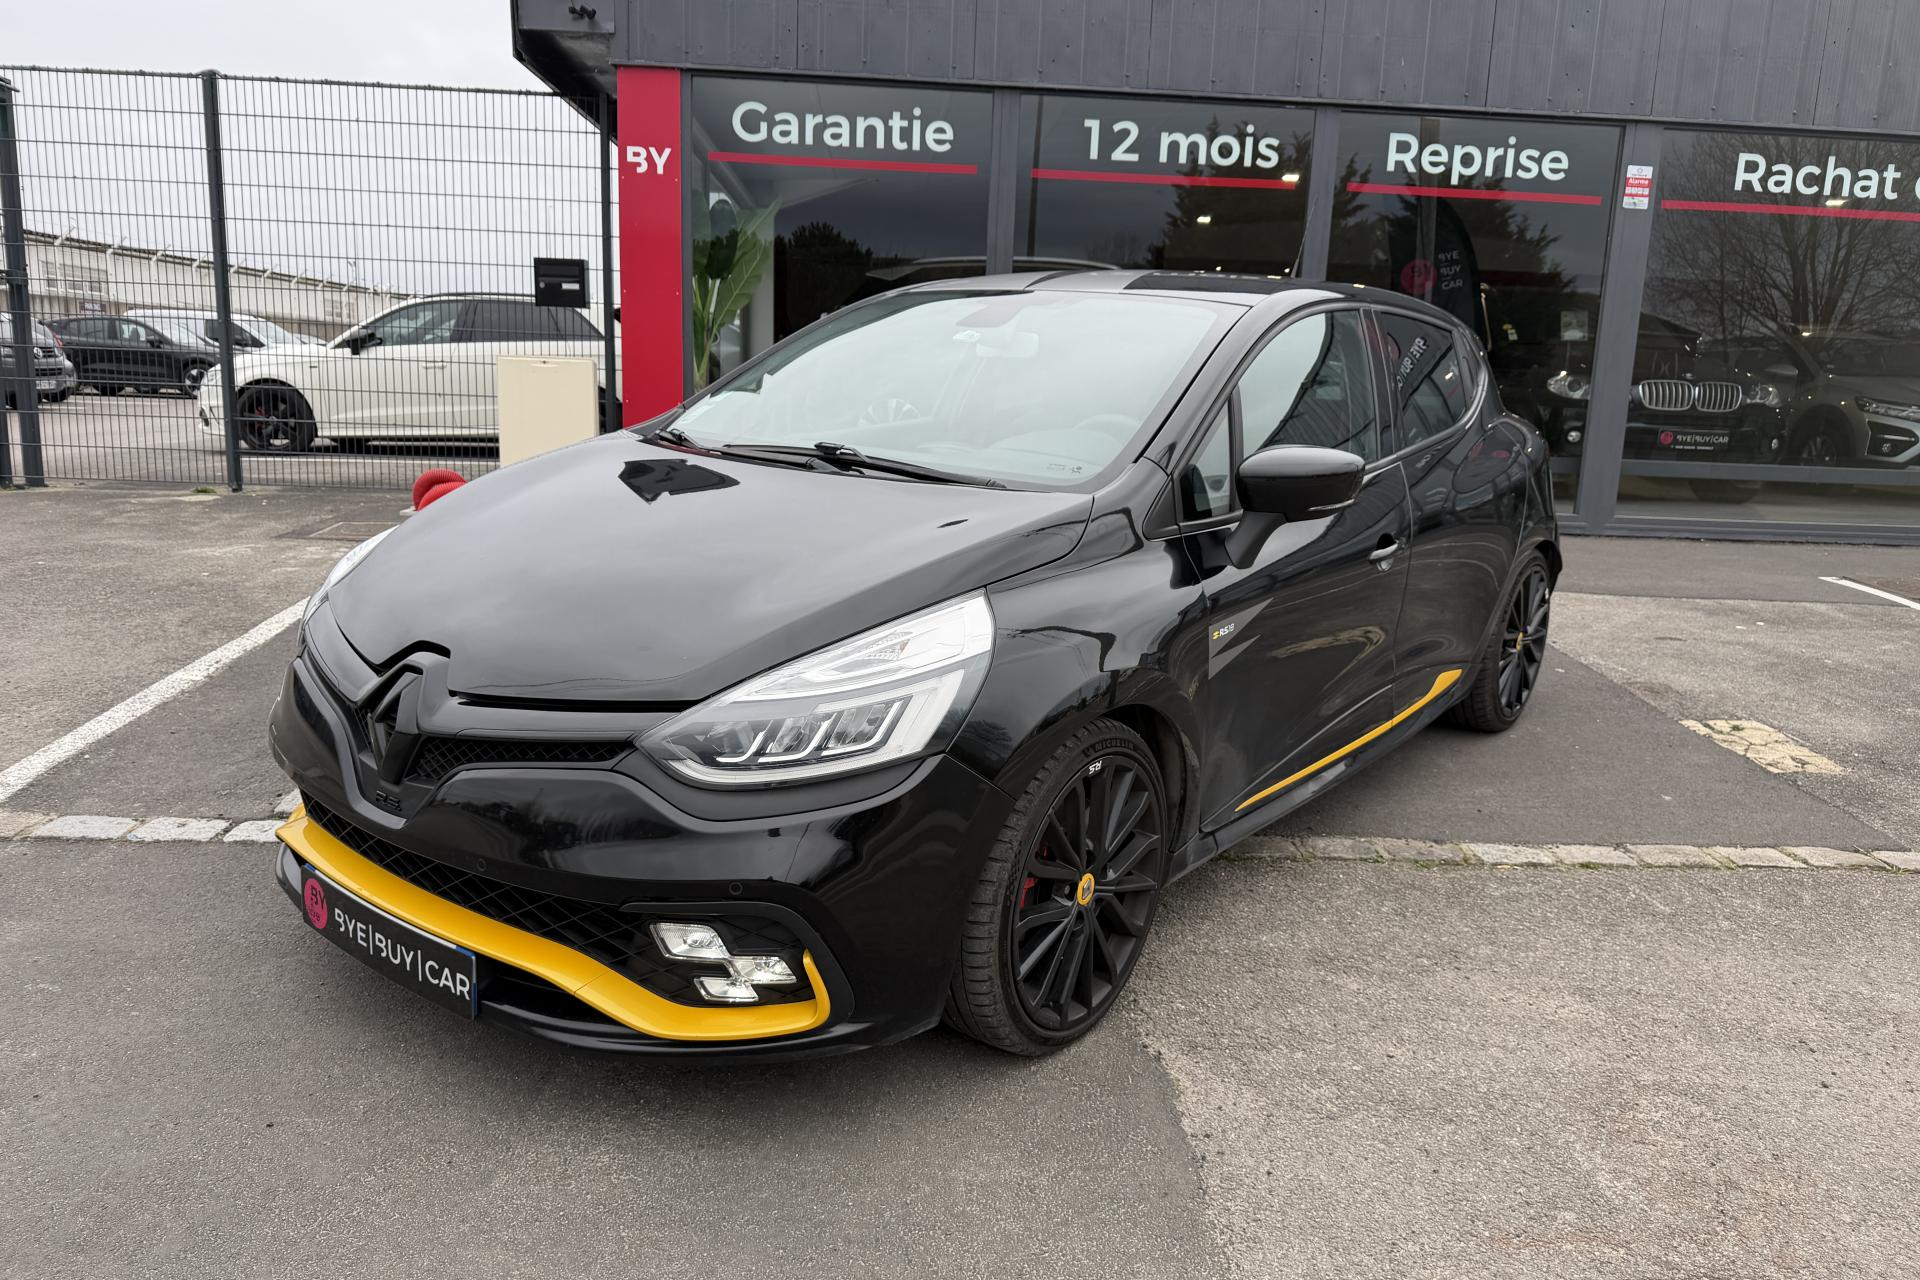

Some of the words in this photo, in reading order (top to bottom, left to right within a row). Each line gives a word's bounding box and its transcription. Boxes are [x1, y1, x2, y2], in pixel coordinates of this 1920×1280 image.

[731, 101, 954, 153] Garantie
[1084, 118, 1140, 162] 12
[1159, 124, 1281, 169] mois
[626, 145, 672, 175] BY
[1386, 132, 1569, 186] Reprise
[1734, 152, 1902, 200] Rachat
[1441, 279, 1463, 290] CAR
